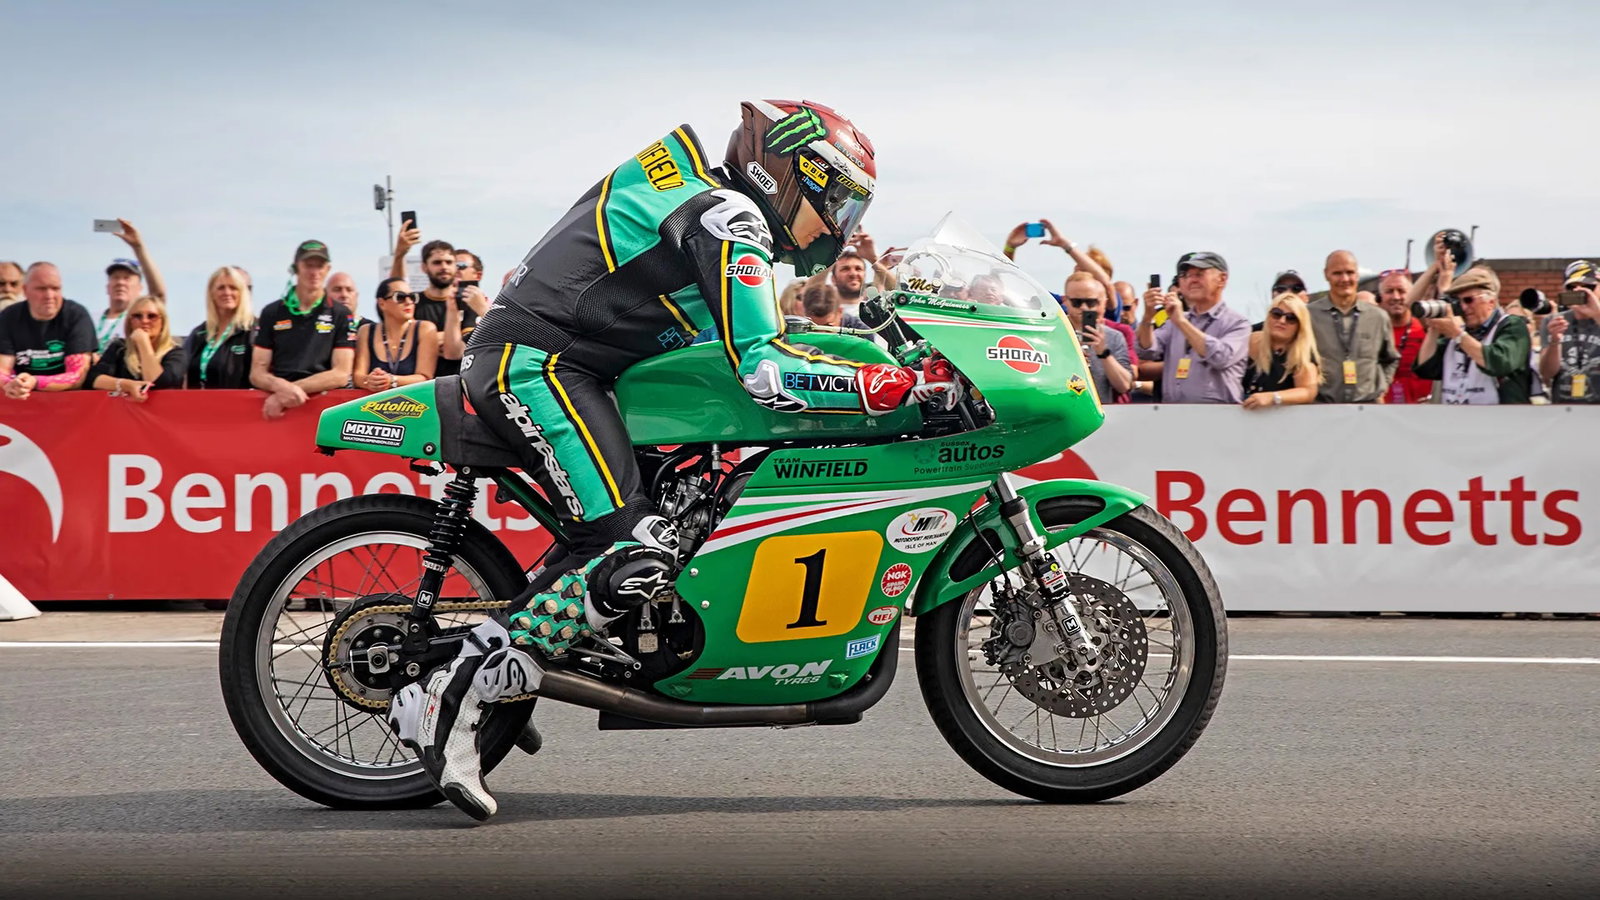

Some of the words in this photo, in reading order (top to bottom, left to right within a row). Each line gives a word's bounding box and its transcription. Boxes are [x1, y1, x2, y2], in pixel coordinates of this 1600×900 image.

[750, 165, 774, 191] SHOEI
[908, 296, 926, 304] John
[987, 348, 1049, 364] SHORAI
[361, 401, 427, 414] Putoline
[345, 423, 401, 439] MAXTON
[500, 393, 584, 516] alpinestars
[938, 443, 1005, 463] autos
[774, 462, 868, 479] WINFIELD
[914, 465, 962, 475] Powertrain
[1155, 470, 1583, 547] Bennetts
[887, 570, 908, 580] NGK
[786, 549, 828, 629] 1
[420, 592, 431, 604] M
[873, 613, 893, 621] HEL
[1066, 618, 1078, 631] M
[848, 640, 877, 657] FLACK
[717, 659, 833, 680] AVON
[775, 676, 821, 686] TYRES
